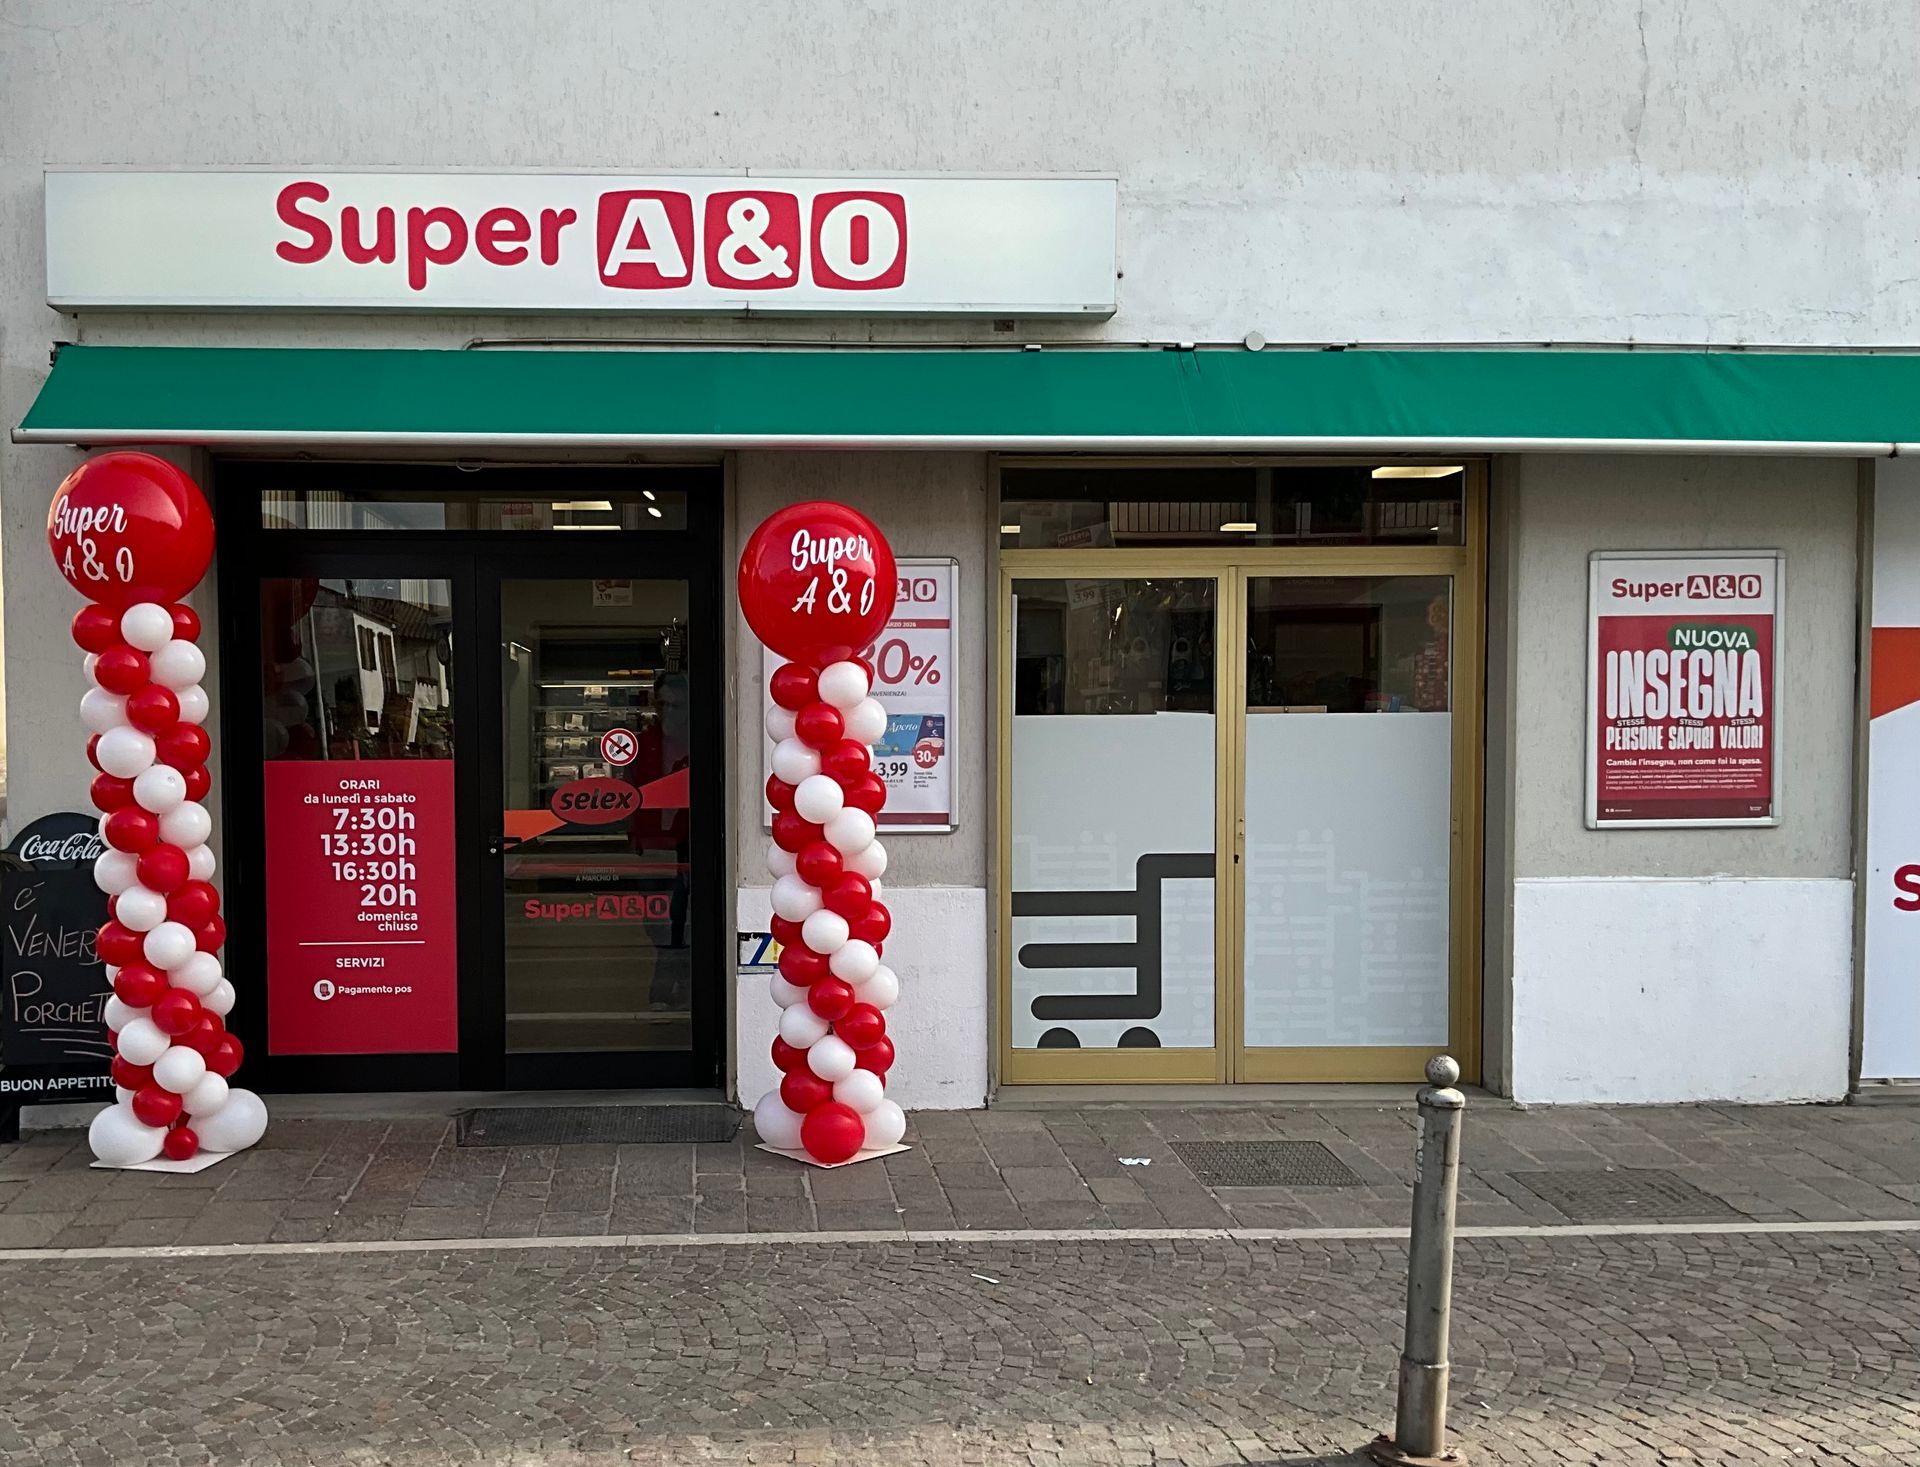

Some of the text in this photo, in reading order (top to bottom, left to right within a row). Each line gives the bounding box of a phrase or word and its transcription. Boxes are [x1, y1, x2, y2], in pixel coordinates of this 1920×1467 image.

[275, 180, 907, 291] Super A&O
[54, 494, 128, 546] Super
[791, 529, 873, 575] Super
[1611, 578, 1685, 603] Super
[1674, 628, 1751, 649] NUOVA
[1605, 648, 1764, 720] INSEGNA
[1616, 717, 1646, 727] STESSE
[1679, 718, 1704, 727] STESSI
[1730, 717, 1756, 726] STESSI
[1605, 724, 1764, 751] PERSONE SAPORI VALORI
[873, 761, 909, 779] 3,99
[1605, 757, 1638, 766] Cambia
[1638, 757, 1677, 767] l'insegna,
[339, 779, 381, 790] ORARI
[303, 792, 417, 804] da lunedì a sabato
[559, 787, 634, 811] selex
[332, 806, 416, 831] 7:30h
[320, 832, 416, 856] 13:30h
[331, 857, 417, 881] 16:30h
[360, 883, 418, 907] 20h
[357, 910, 418, 922] domenica
[524, 898, 595, 922] Super
[377, 921, 419, 932] chiuso
[335, 957, 385, 968] SERVIZI
[338, 984, 413, 996] Pagamento pos
[0, 1079, 44, 1092] BUON
